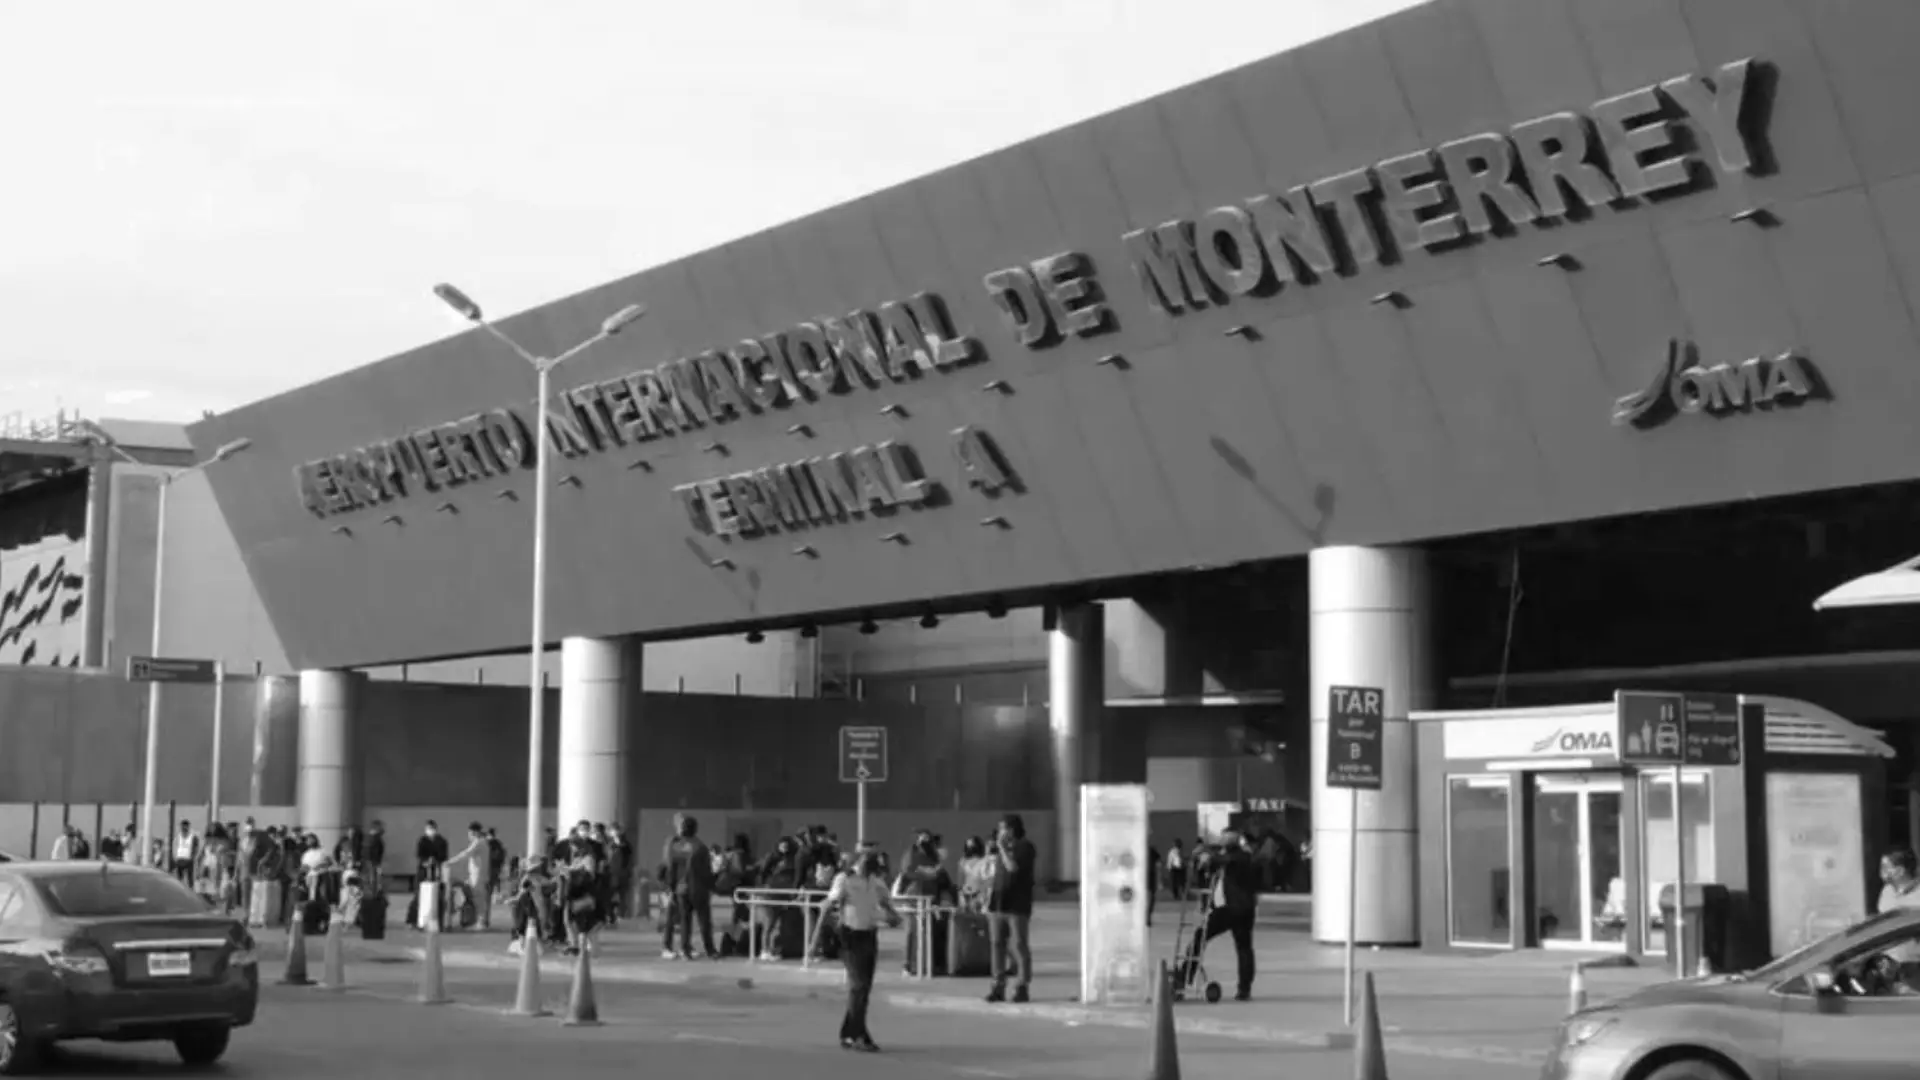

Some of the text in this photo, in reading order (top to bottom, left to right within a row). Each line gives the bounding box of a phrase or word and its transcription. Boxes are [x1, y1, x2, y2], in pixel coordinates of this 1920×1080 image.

[531, 292, 986, 460] NTERNACIONAL
[984, 250, 1119, 348] DE
[1121, 57, 1777, 314] MONTERREY
[1669, 350, 1831, 418] OMA
[671, 425, 1026, 541] TERMINAL A
[1332, 688, 1380, 716] TAR
[1560, 731, 1613, 751] OMA
[1247, 797, 1286, 813] TAXI
